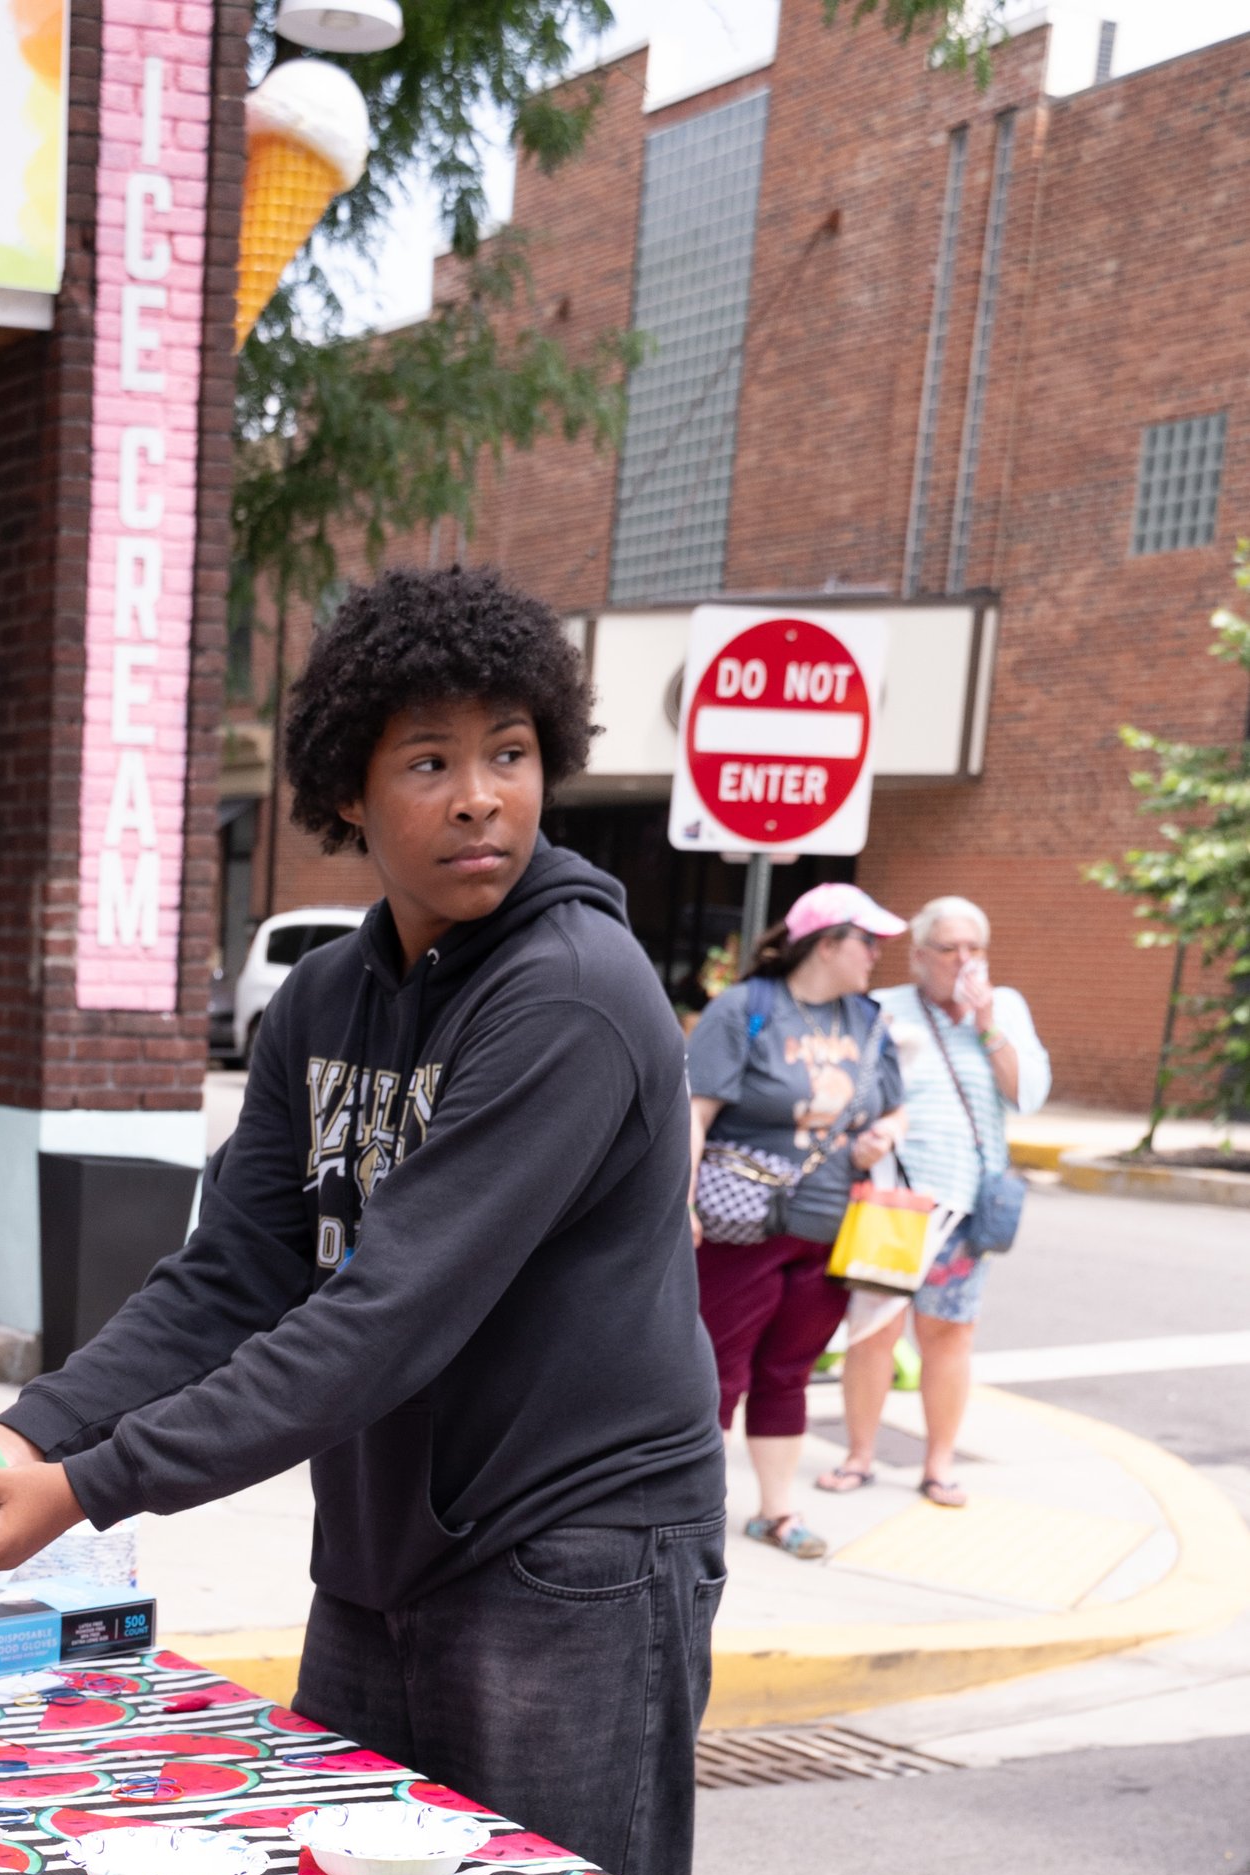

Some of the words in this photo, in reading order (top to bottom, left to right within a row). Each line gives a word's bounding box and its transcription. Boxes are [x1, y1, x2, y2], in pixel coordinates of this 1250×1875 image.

[120, 56, 173, 392] ICE
[97, 426, 165, 947] CREAM
[715, 657, 767, 699] DO
[783, 660, 854, 703] NOT
[718, 761, 828, 805] ENTER
[124, 1614, 146, 1629] 500
[124, 1624, 149, 1637] COUNT
[23, 1637, 58, 1651] GLOVES
